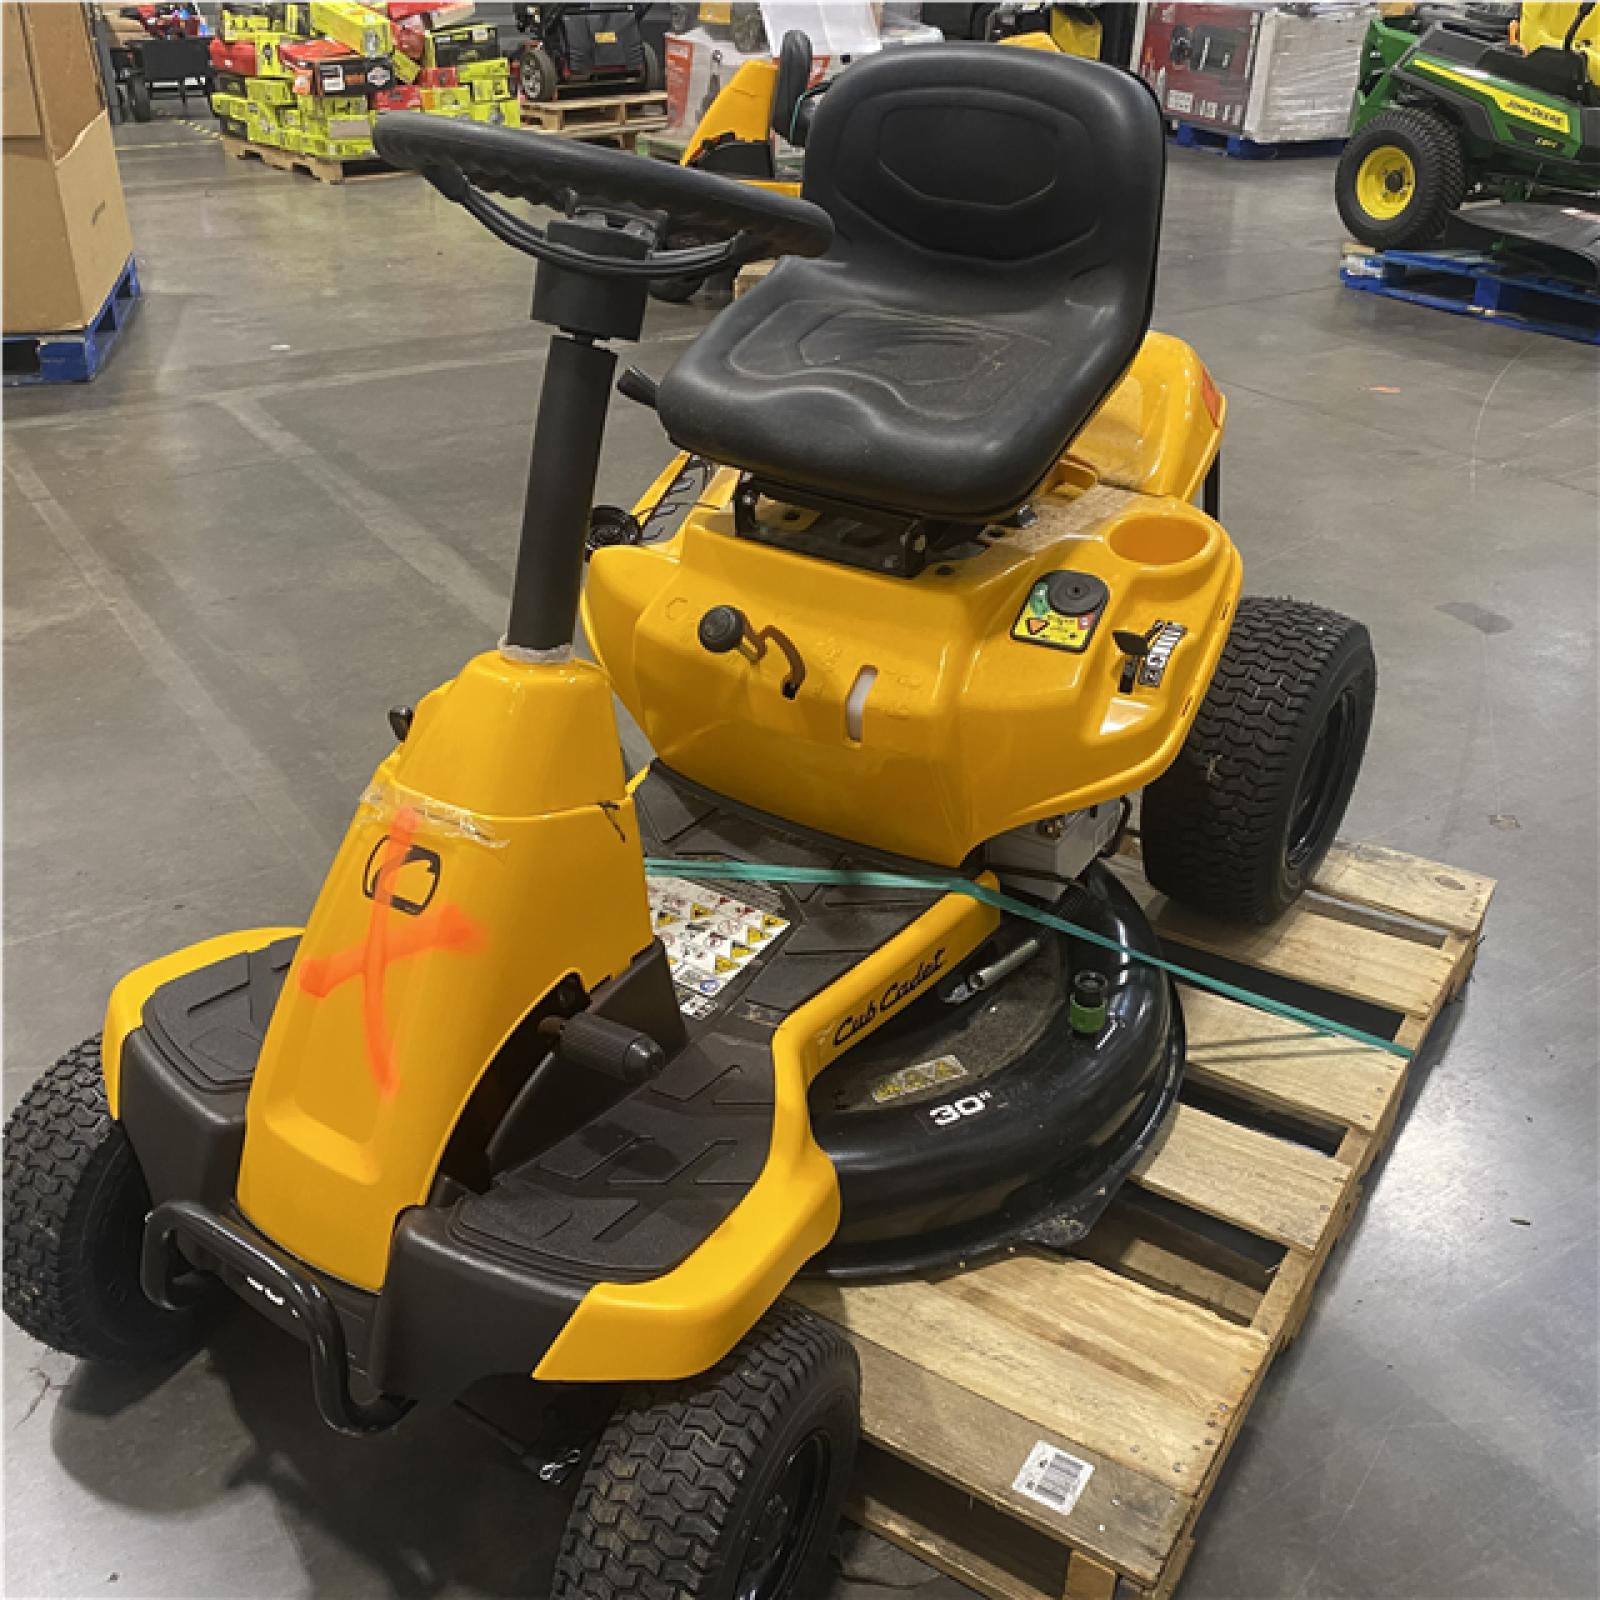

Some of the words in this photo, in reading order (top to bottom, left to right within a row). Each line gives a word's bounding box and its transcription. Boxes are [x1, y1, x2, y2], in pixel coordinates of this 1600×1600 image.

[833, 1000, 876, 1046] Cub
[879, 947, 946, 1012] Cadet
[929, 1090, 992, 1125] 30"
